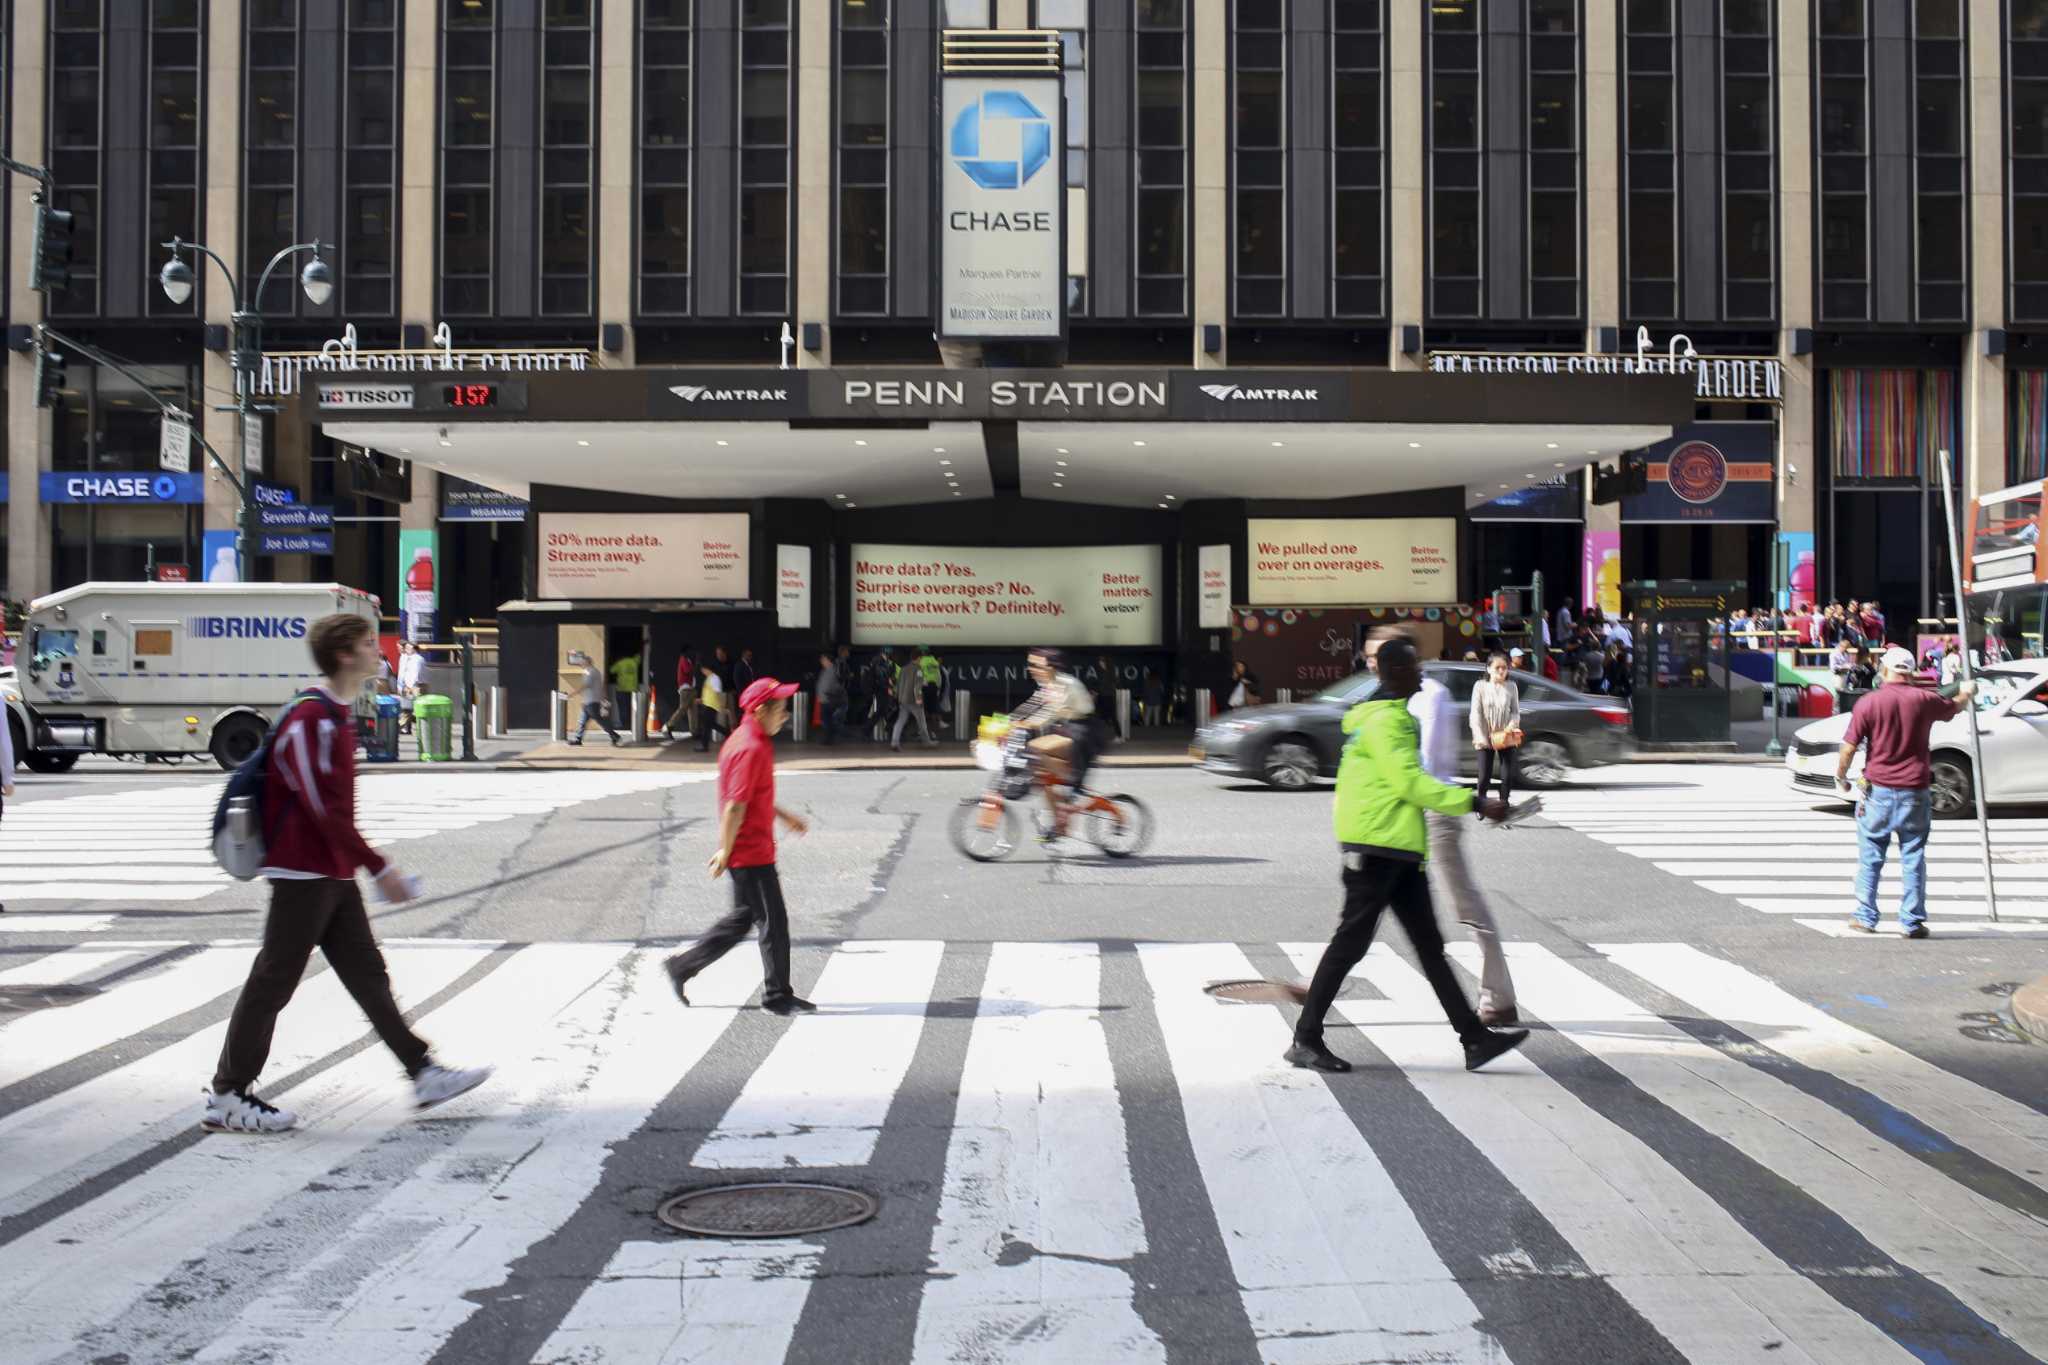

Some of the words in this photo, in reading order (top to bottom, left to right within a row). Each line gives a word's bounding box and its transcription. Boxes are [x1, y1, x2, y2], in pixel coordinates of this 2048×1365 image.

[950, 211, 1051, 232] CHASE
[960, 268, 1003, 281] Marquee
[1006, 268, 1041, 280] Partner
[950, 307, 985, 321] MADISON
[1020, 307, 1053, 321] GARDEN
[347, 391, 413, 404] TISSOT
[701, 390, 788, 401] AMTRAK
[845, 381, 964, 405] PENN
[991, 381, 1166, 406] STATION
[1232, 389, 1319, 400] AMTRAK
[67, 478, 150, 497] CHASE
[262, 511, 306, 524] Seventh
[308, 511, 329, 523] Ave
[265, 537, 282, 550] Joe
[283, 537, 310, 550] Louis
[547, 533, 582, 547] 30%
[585, 536, 623, 547] more
[626, 533, 663, 547] data.
[1257, 542, 1281, 556] We
[1283, 542, 1328, 557] pulled
[1330, 544, 1359, 555] one
[1410, 546, 1440, 554] Better
[547, 550, 601, 563] Stream
[603, 552, 646, 566] away.
[1410, 556, 1449, 565] matters.
[856, 561, 895, 576] More
[897, 563, 941, 577] data?
[944, 563, 976, 577] Yes.
[1257, 560, 1289, 571] over
[1292, 560, 1311, 571] on
[1313, 559, 1385, 573] overages.
[1102, 573, 1141, 585] Better
[856, 580, 921, 597] Surprise
[923, 582, 1004, 598] overages?
[1008, 581, 1035, 596] No.
[1102, 587, 1153, 598] matters.
[856, 600, 904, 613] Better
[906, 600, 981, 615] network?
[986, 600, 1065, 617] Definitely.
[1102, 604, 1141, 614] verizon
[207, 617, 307, 638] BRINKS
[1297, 665, 1341, 680] STATE
